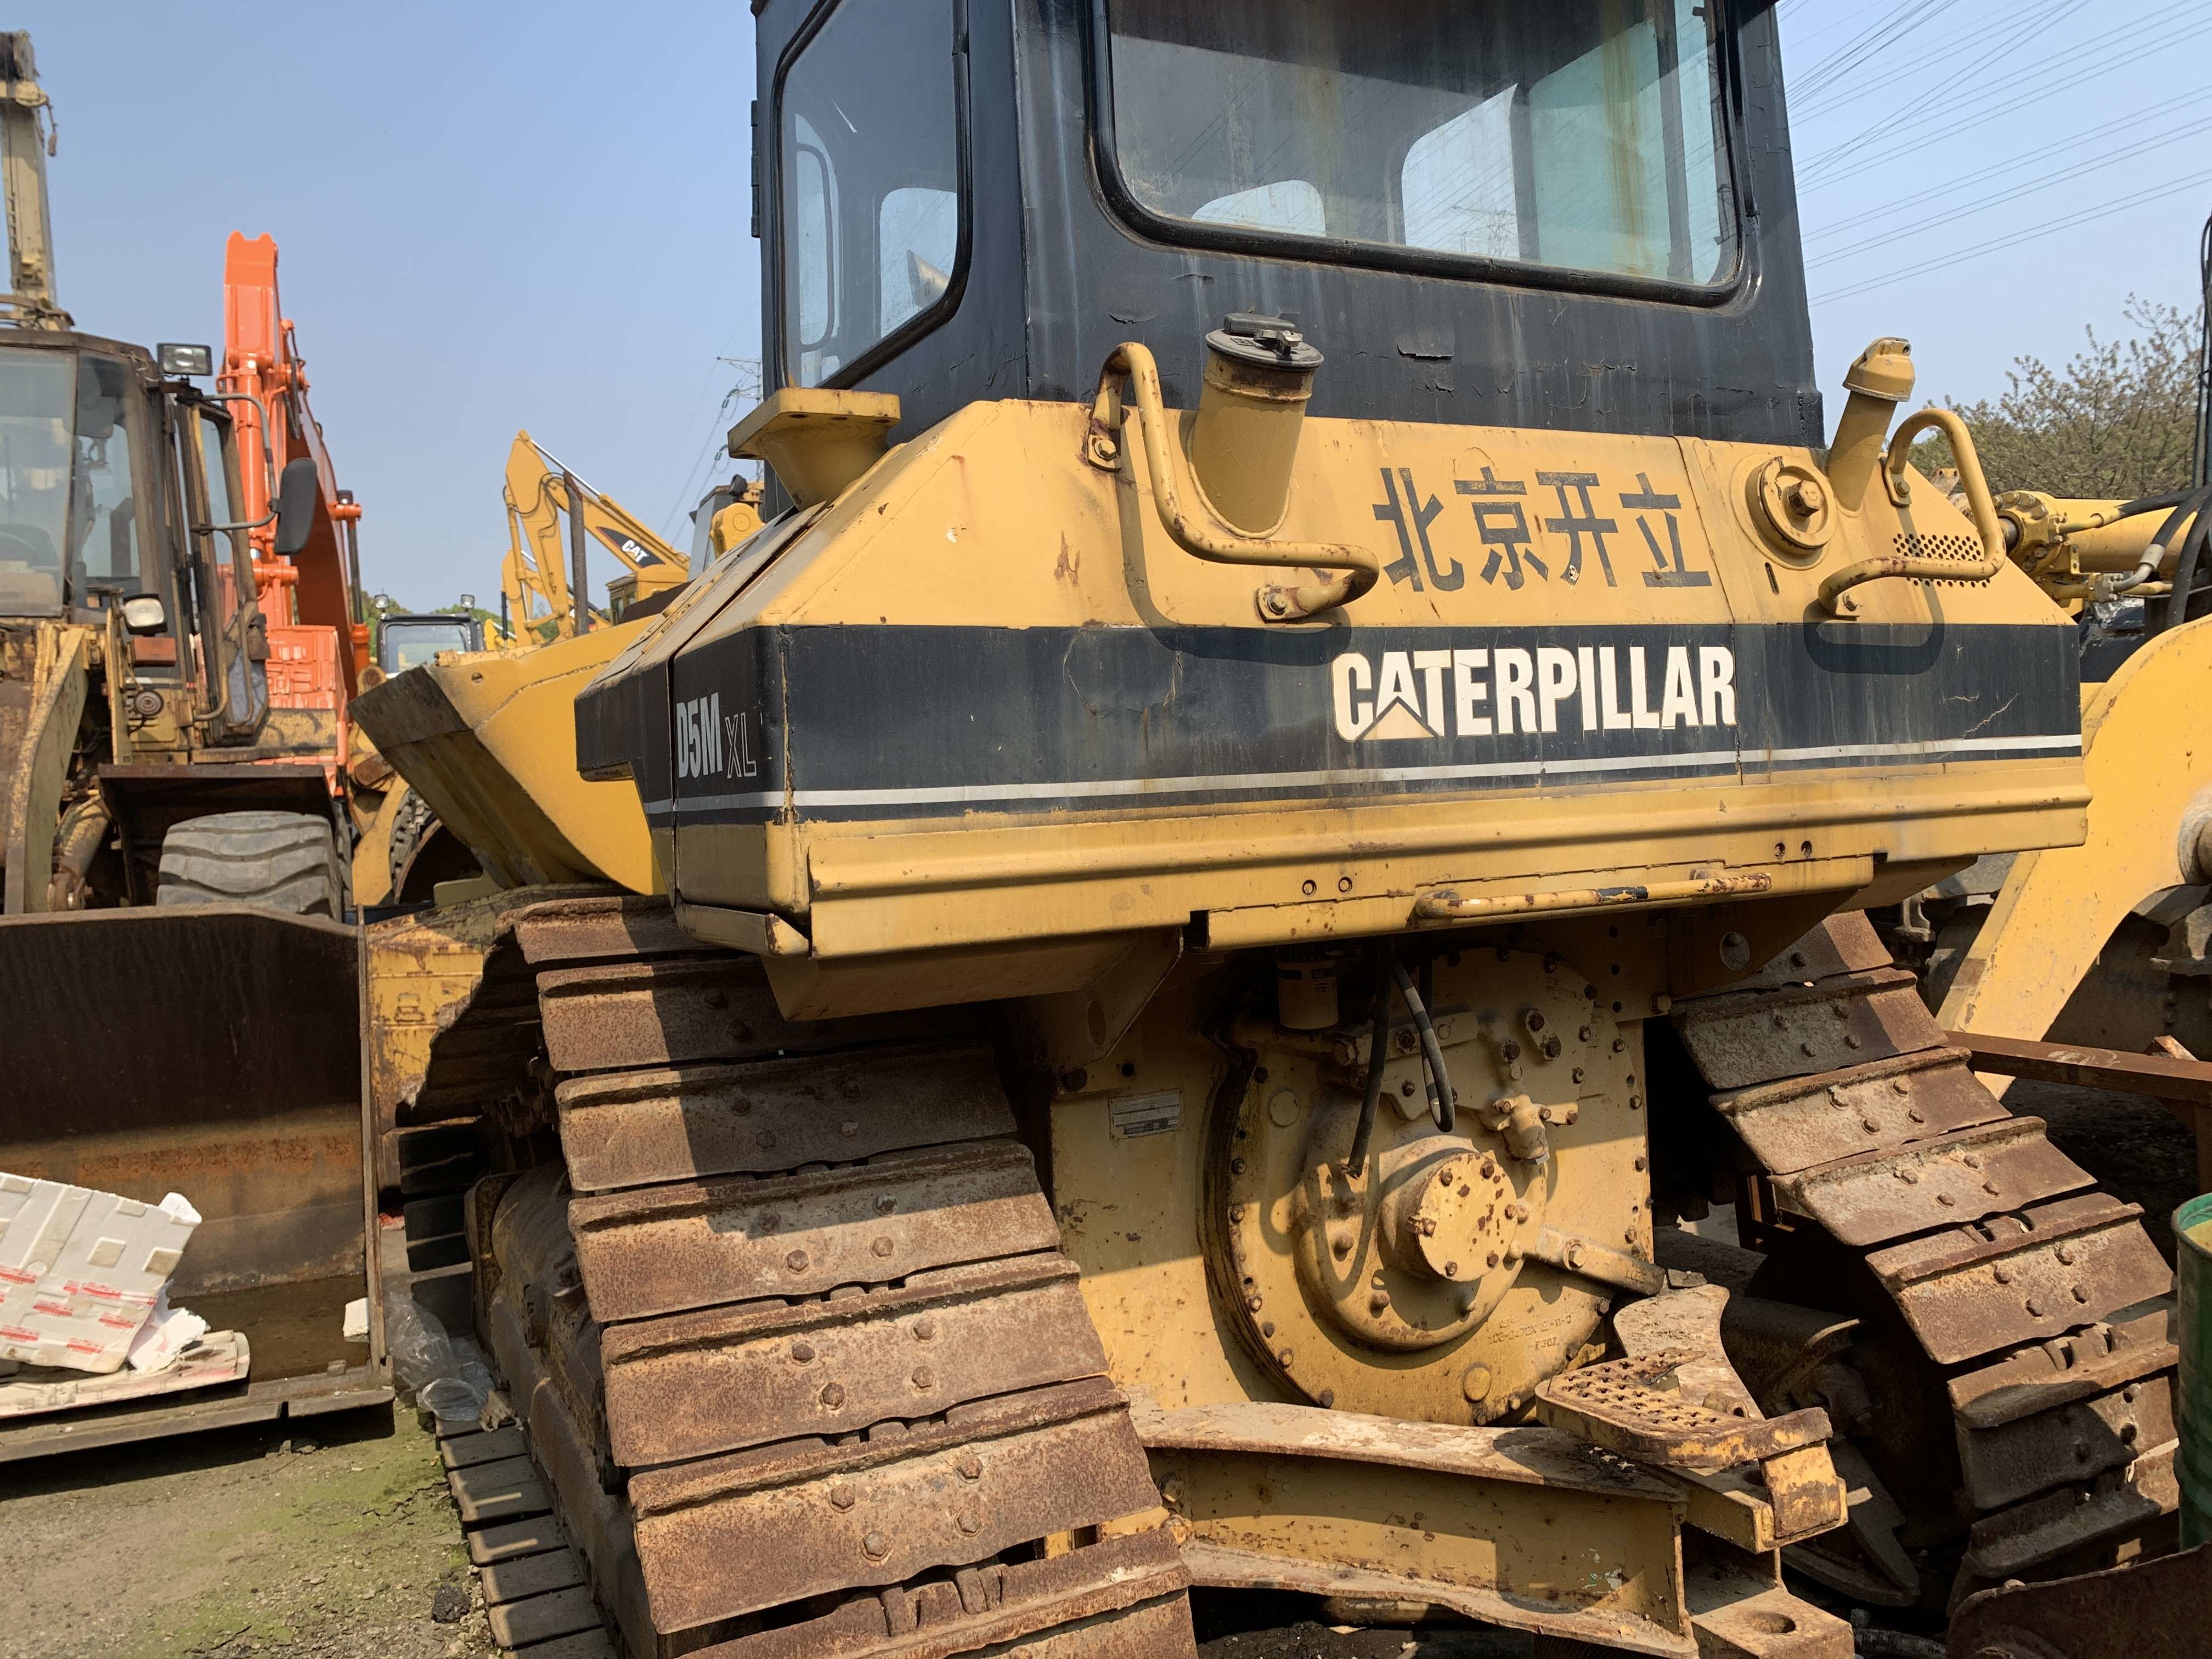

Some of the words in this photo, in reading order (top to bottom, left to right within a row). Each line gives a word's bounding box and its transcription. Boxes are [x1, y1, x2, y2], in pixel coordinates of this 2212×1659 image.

[622, 540, 649, 563] CAT
[1373, 466, 1713, 592] 北京开立
[676, 692, 723, 778] D5M
[724, 712, 757, 779] XL
[1330, 646, 1737, 742] CATERPILLAR
